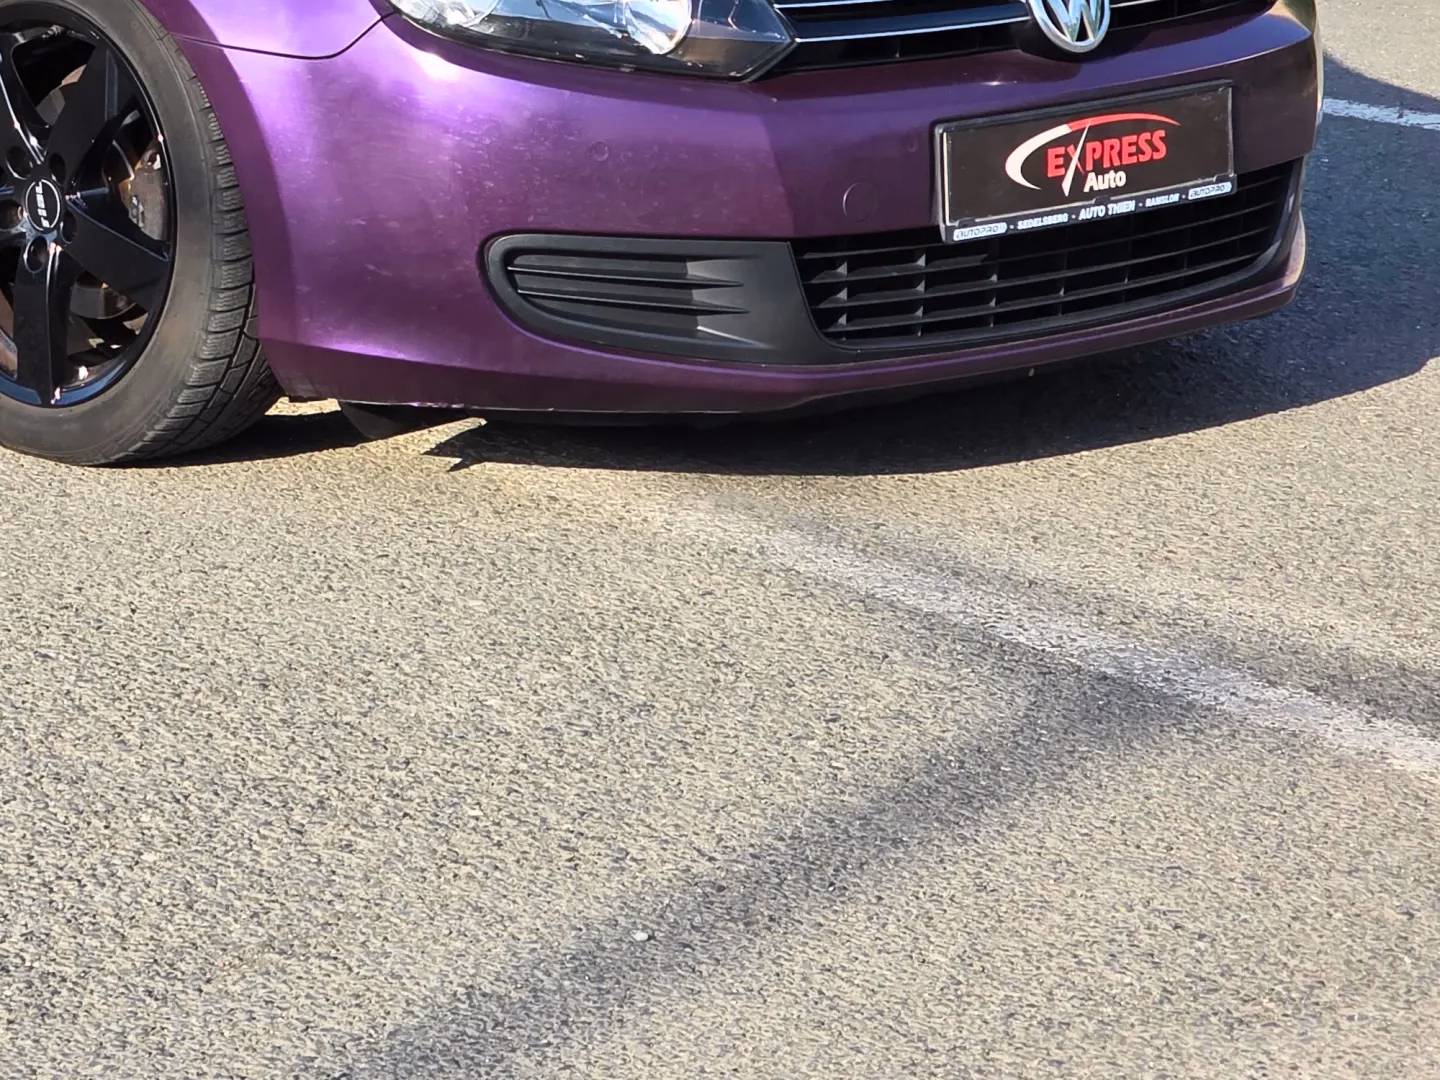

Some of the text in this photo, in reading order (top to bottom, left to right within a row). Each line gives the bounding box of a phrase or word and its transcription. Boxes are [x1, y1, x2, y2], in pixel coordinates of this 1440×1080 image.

[1046, 124, 1167, 195] EXPRESS
[1083, 170, 1127, 193] Auto
[1078, 205, 1106, 221] AUTO
